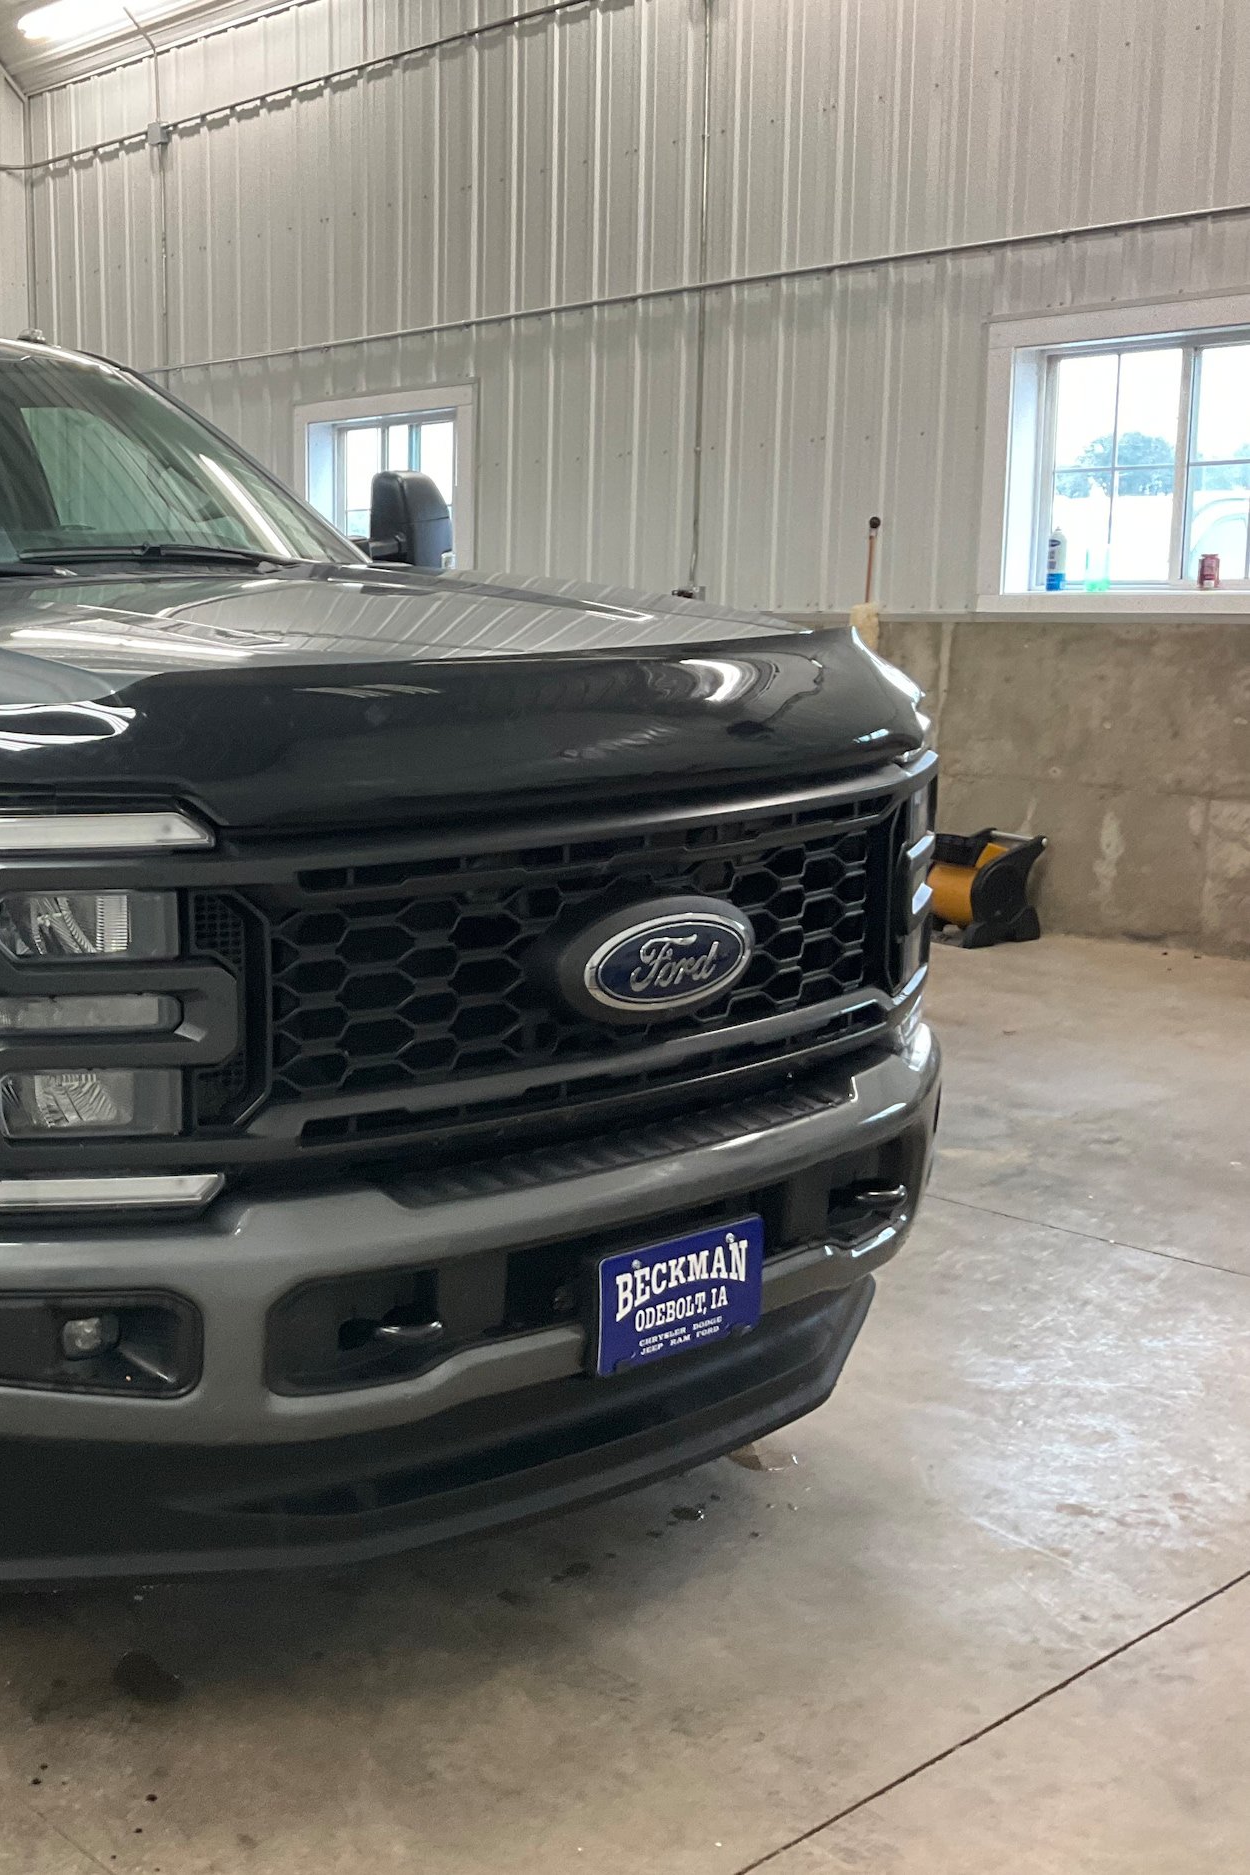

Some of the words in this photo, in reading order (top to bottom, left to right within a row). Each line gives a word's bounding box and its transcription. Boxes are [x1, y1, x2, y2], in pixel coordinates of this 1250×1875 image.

[630, 934, 719, 992] Ford
[616, 1239, 748, 1322] BECKMAN
[635, 1292, 707, 1332] ODEBOLT,
[711, 1285, 729, 1309] IA
[639, 1327, 687, 1347] CHRYSLER
[692, 1315, 722, 1330] DODGE
[640, 1343, 664, 1355] JEEP
[669, 1334, 691, 1346] RAM
[696, 1325, 720, 1338] FORD
